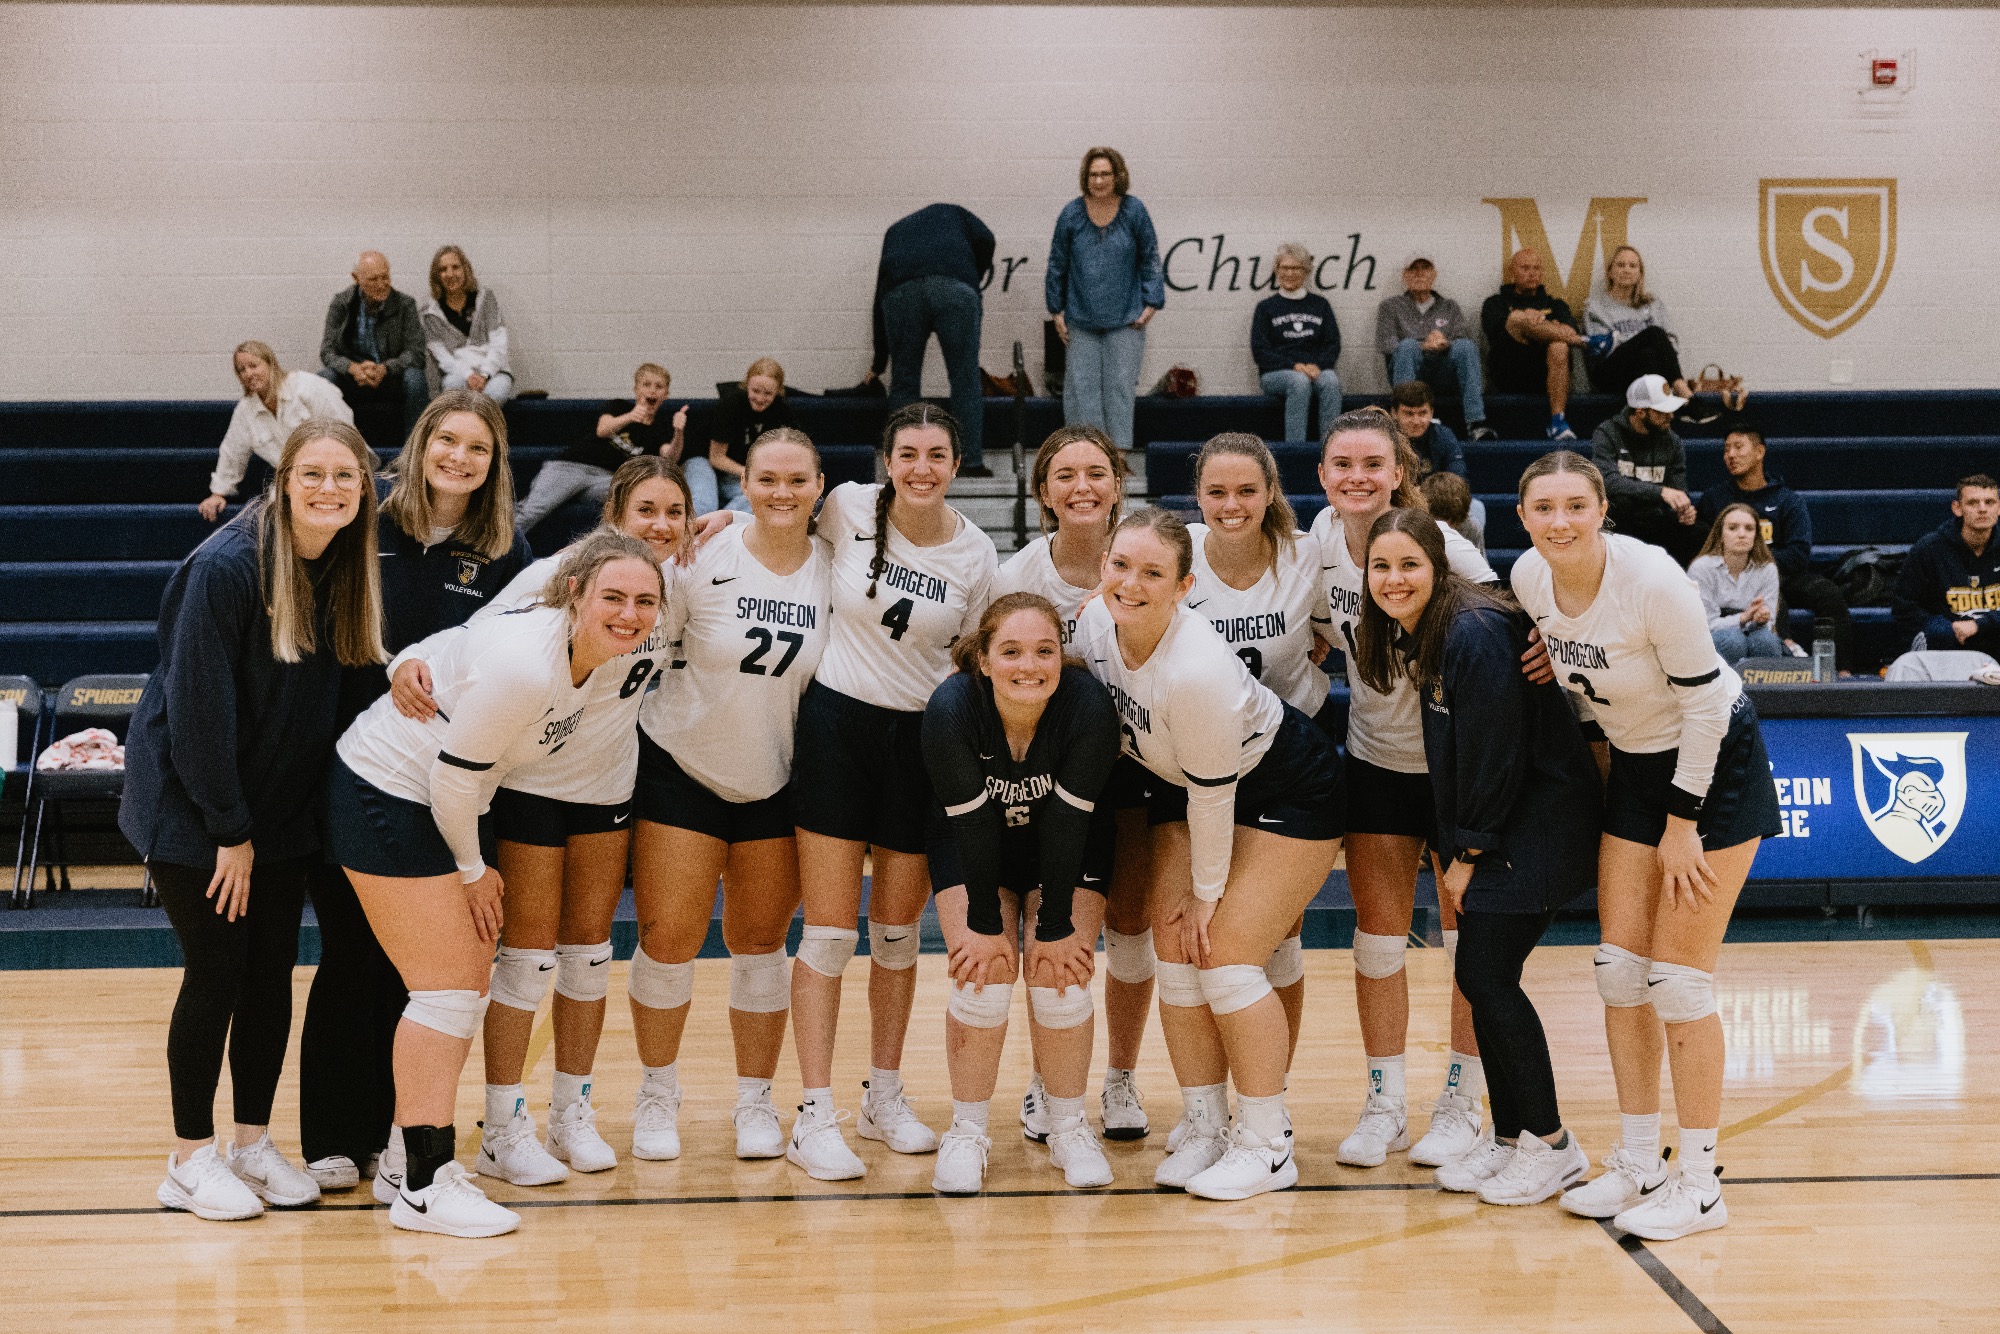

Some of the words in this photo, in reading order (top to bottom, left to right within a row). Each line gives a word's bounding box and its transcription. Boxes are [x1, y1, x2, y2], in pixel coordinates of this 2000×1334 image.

[1162, 233, 1376, 291] Chuch
[1801, 206, 1854, 293] S
[444, 582, 484, 598] VOLLEYBALL
[736, 596, 816, 630] SPURGEON
[881, 597, 915, 641] 4
[1209, 611, 1286, 643] PURGEON
[739, 626, 804, 677] 27
[1547, 635, 1610, 669] SPURGEON
[619, 658, 655, 699] 8
[1568, 673, 1612, 706] 2
[71, 687, 144, 706] SPURGEO
[985, 773, 1053, 806] SPURGEON
